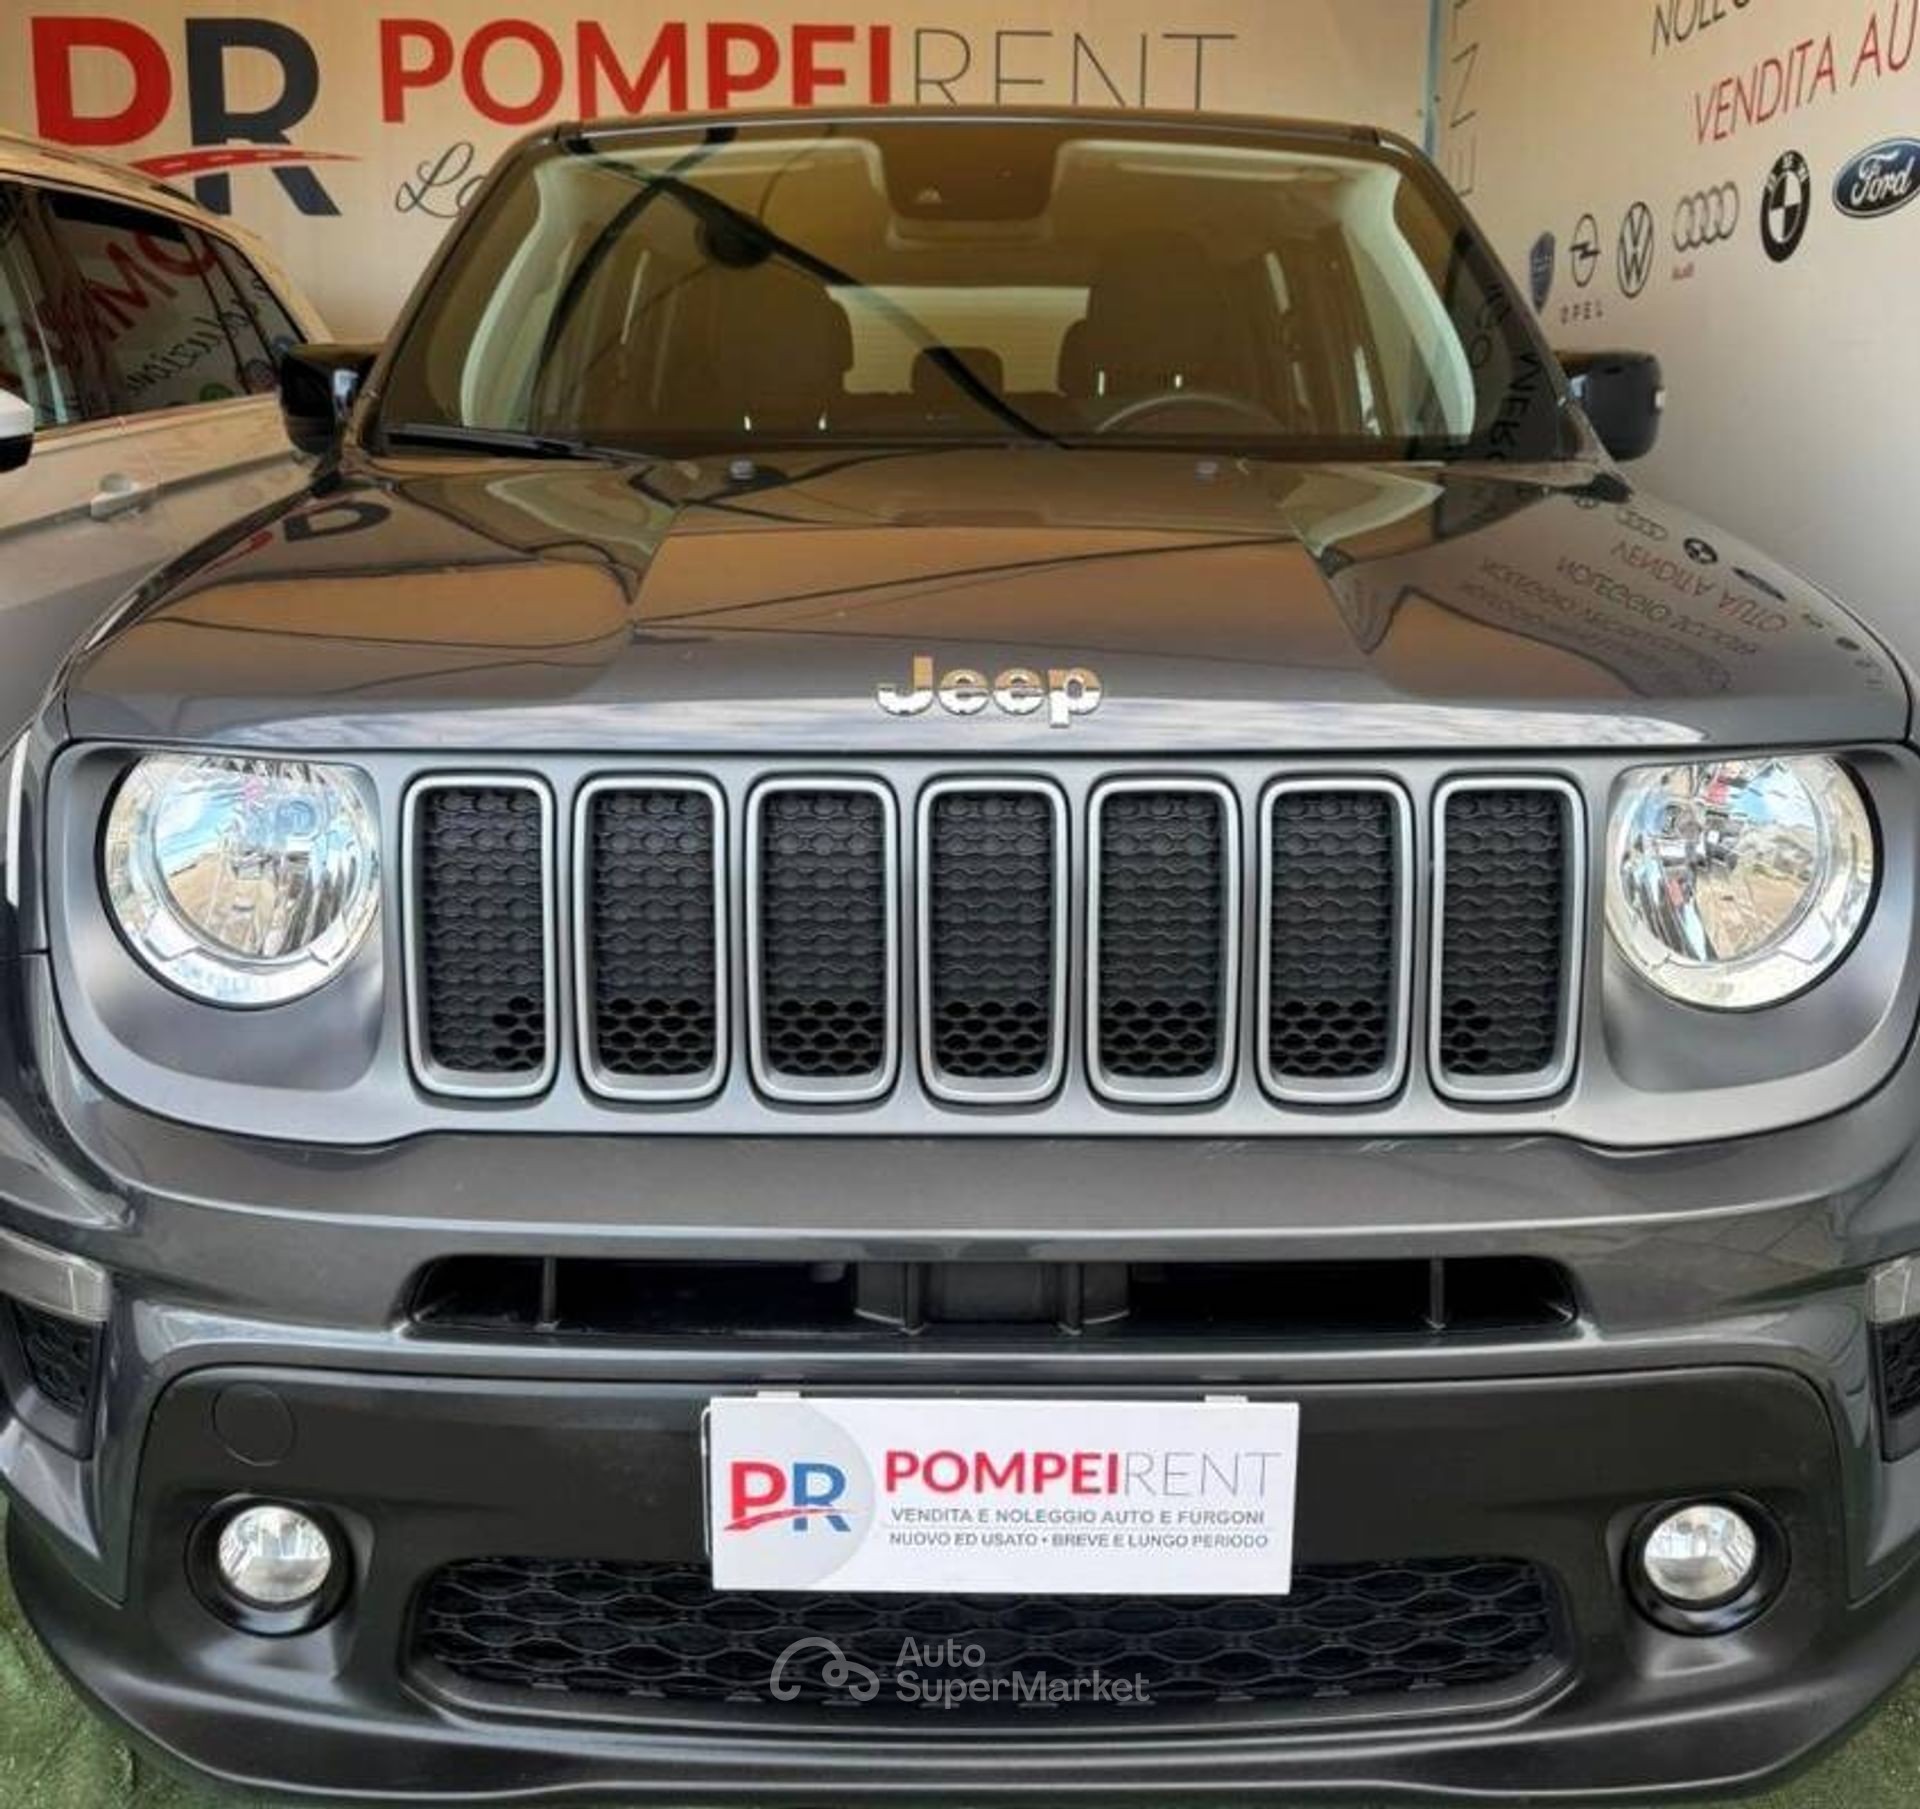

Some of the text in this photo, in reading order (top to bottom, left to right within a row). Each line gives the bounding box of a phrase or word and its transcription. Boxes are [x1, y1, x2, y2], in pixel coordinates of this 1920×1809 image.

[1694, 0, 1920, 146] VENDITA AU
[1850, 149, 1916, 207] Ford
[876, 655, 1101, 729] Jeep
[725, 1461, 853, 1533] PR
[885, 1449, 1283, 1498] POMPEIRENT
[889, 1531, 1269, 1549] NUOVO ED USATO BREVE E LUNGO PERIODO
[891, 1507, 1265, 1526] VENDITA E NOLEGGIO AUTO E FURGONI
